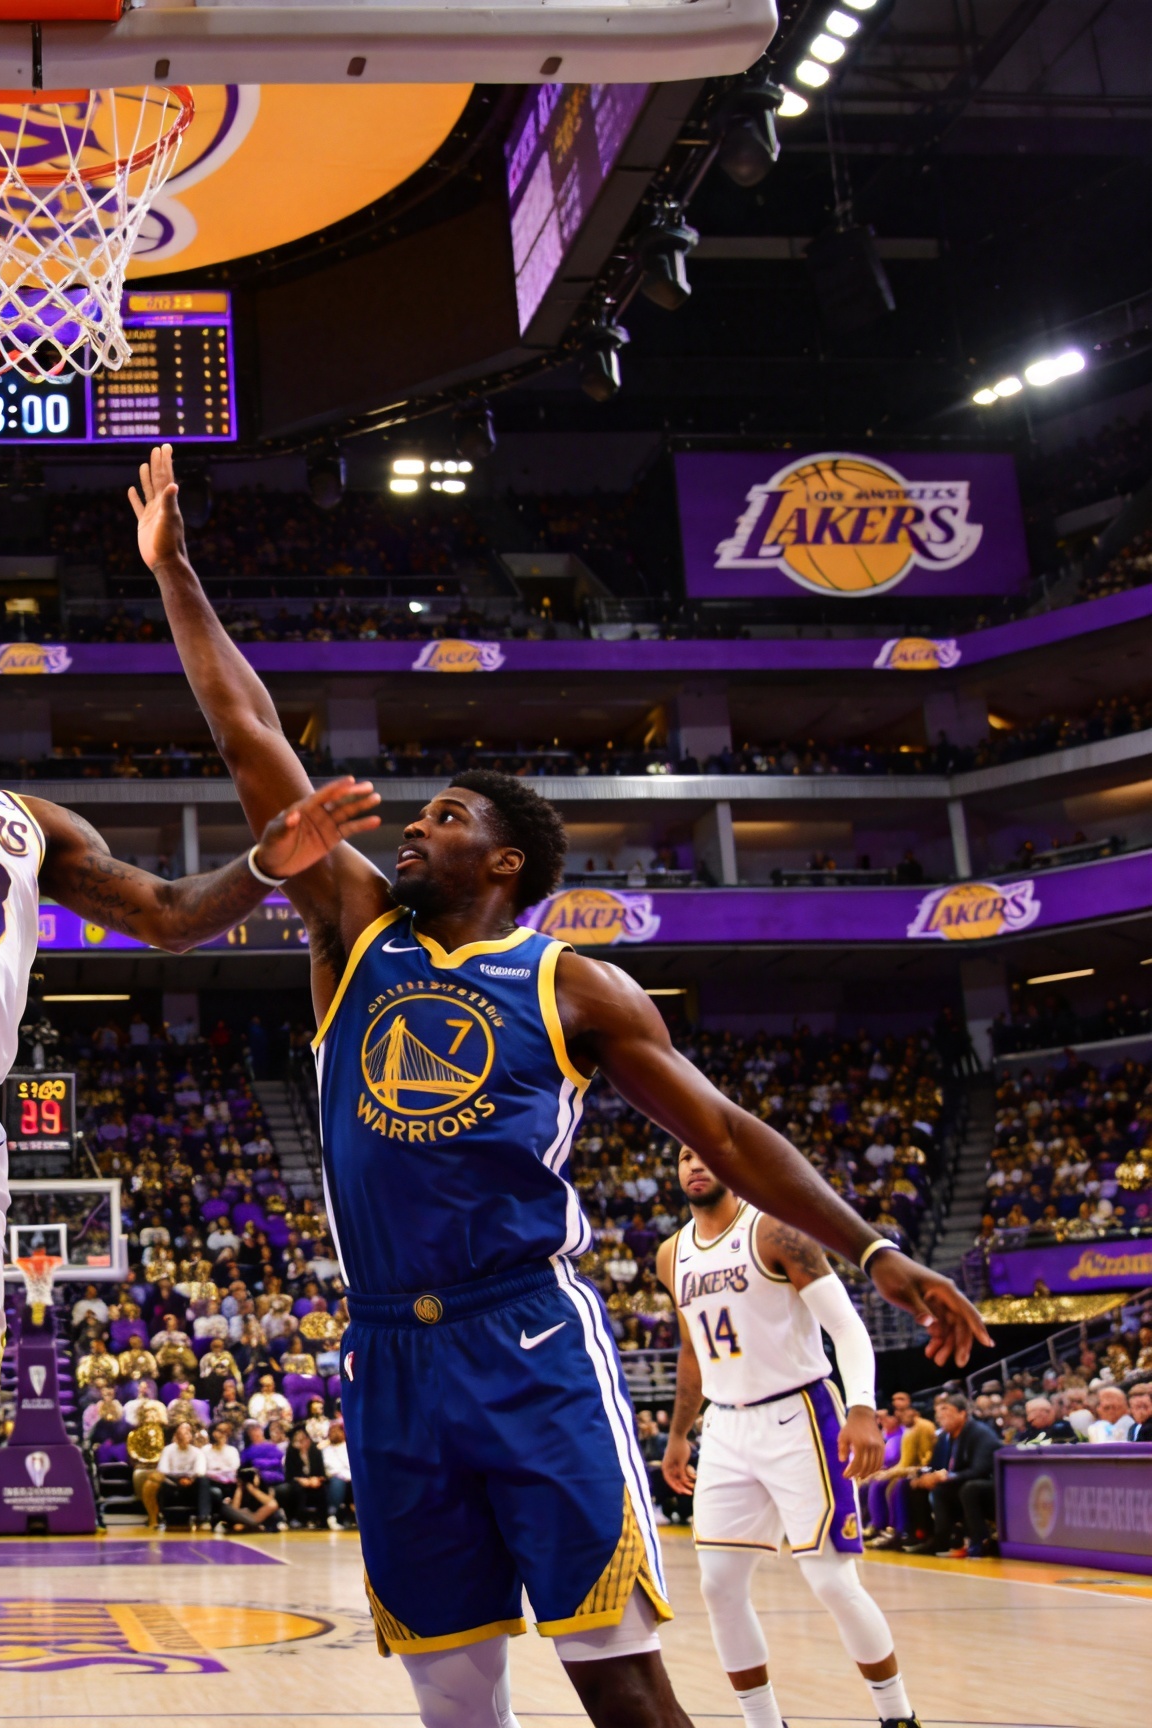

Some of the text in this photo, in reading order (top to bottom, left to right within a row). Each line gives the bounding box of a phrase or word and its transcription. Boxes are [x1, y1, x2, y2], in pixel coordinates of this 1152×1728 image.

[730, 488, 970, 562] LAKERS
[445, 1018, 474, 1055] 7
[357, 1092, 496, 1143] WARRIORS
[698, 1306, 743, 1362] 14
